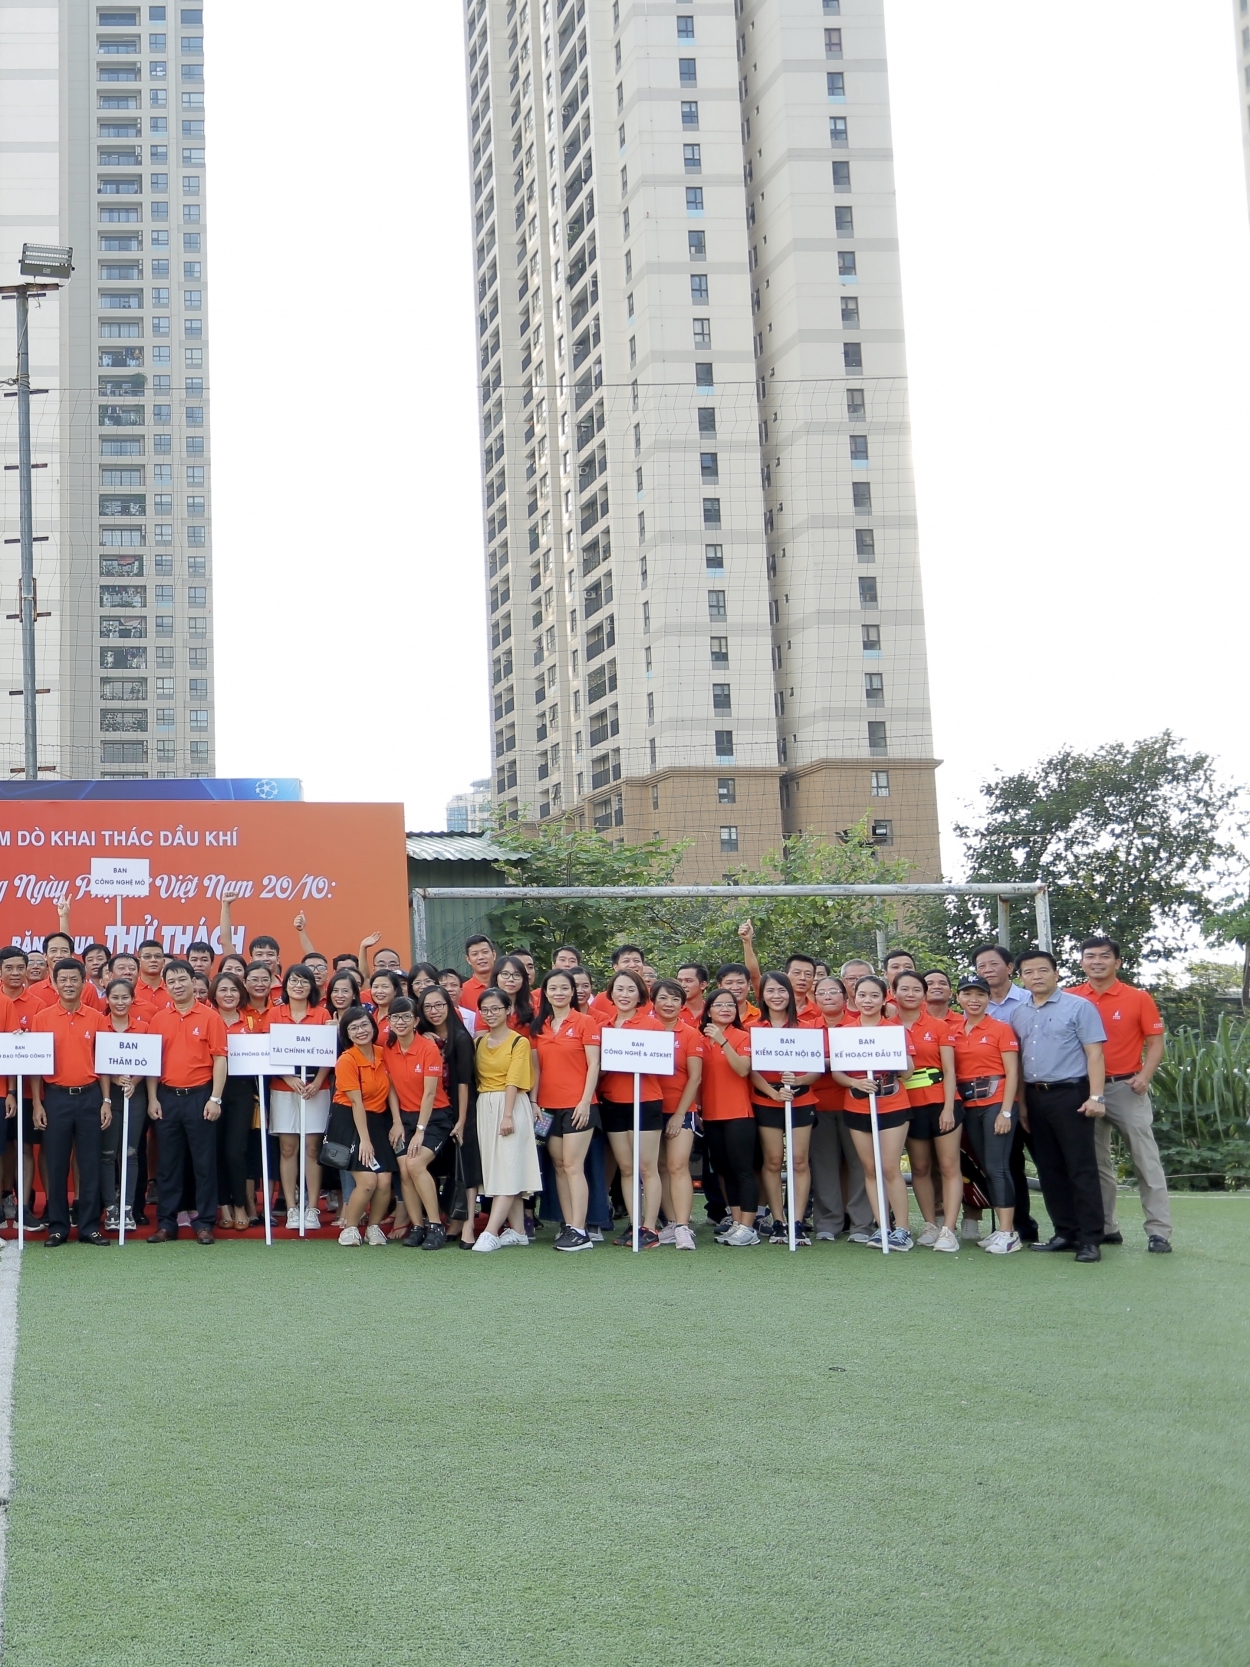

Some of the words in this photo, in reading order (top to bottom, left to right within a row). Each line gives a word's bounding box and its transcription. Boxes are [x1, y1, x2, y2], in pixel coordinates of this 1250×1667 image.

[17, 827, 45, 847] DÒ
[51, 830, 96, 847] KHAI
[101, 826, 154, 847] THÁC
[159, 824, 199, 847] DẦU
[205, 826, 239, 847] KHÍ
[116, 879, 133, 887] NGHỆ
[13, 873, 70, 906] Ngày
[154, 873, 199, 904] Việt
[203, 873, 255, 901] Nam
[258, 873, 337, 901] 20/10:
[10, 929, 46, 954] BĂN
[104, 913, 159, 955] THỬ
[160, 916, 246, 955] THÁCH
[119, 1042, 138, 1050] BAN
[307, 1046, 315, 1054] KẾ
[316, 1047, 334, 1055] TOÁN
[603, 1047, 623, 1055] CÔNG
[624, 1049, 642, 1057] NGHỆ
[755, 1048, 773, 1057] KIỂM
[774, 1049, 793, 1057] SOÁT
[794, 1049, 809, 1060] NỘI
[811, 1049, 822, 1060] BỘ
[834, 1050, 843, 1058] KẾ
[844, 1051, 873, 1060] HOẠCH
[875, 1049, 891, 1058] ĐẦU
[892, 1050, 903, 1058] TƯ
[108, 1057, 132, 1066] THĂM
[134, 1057, 148, 1066] DÒ
